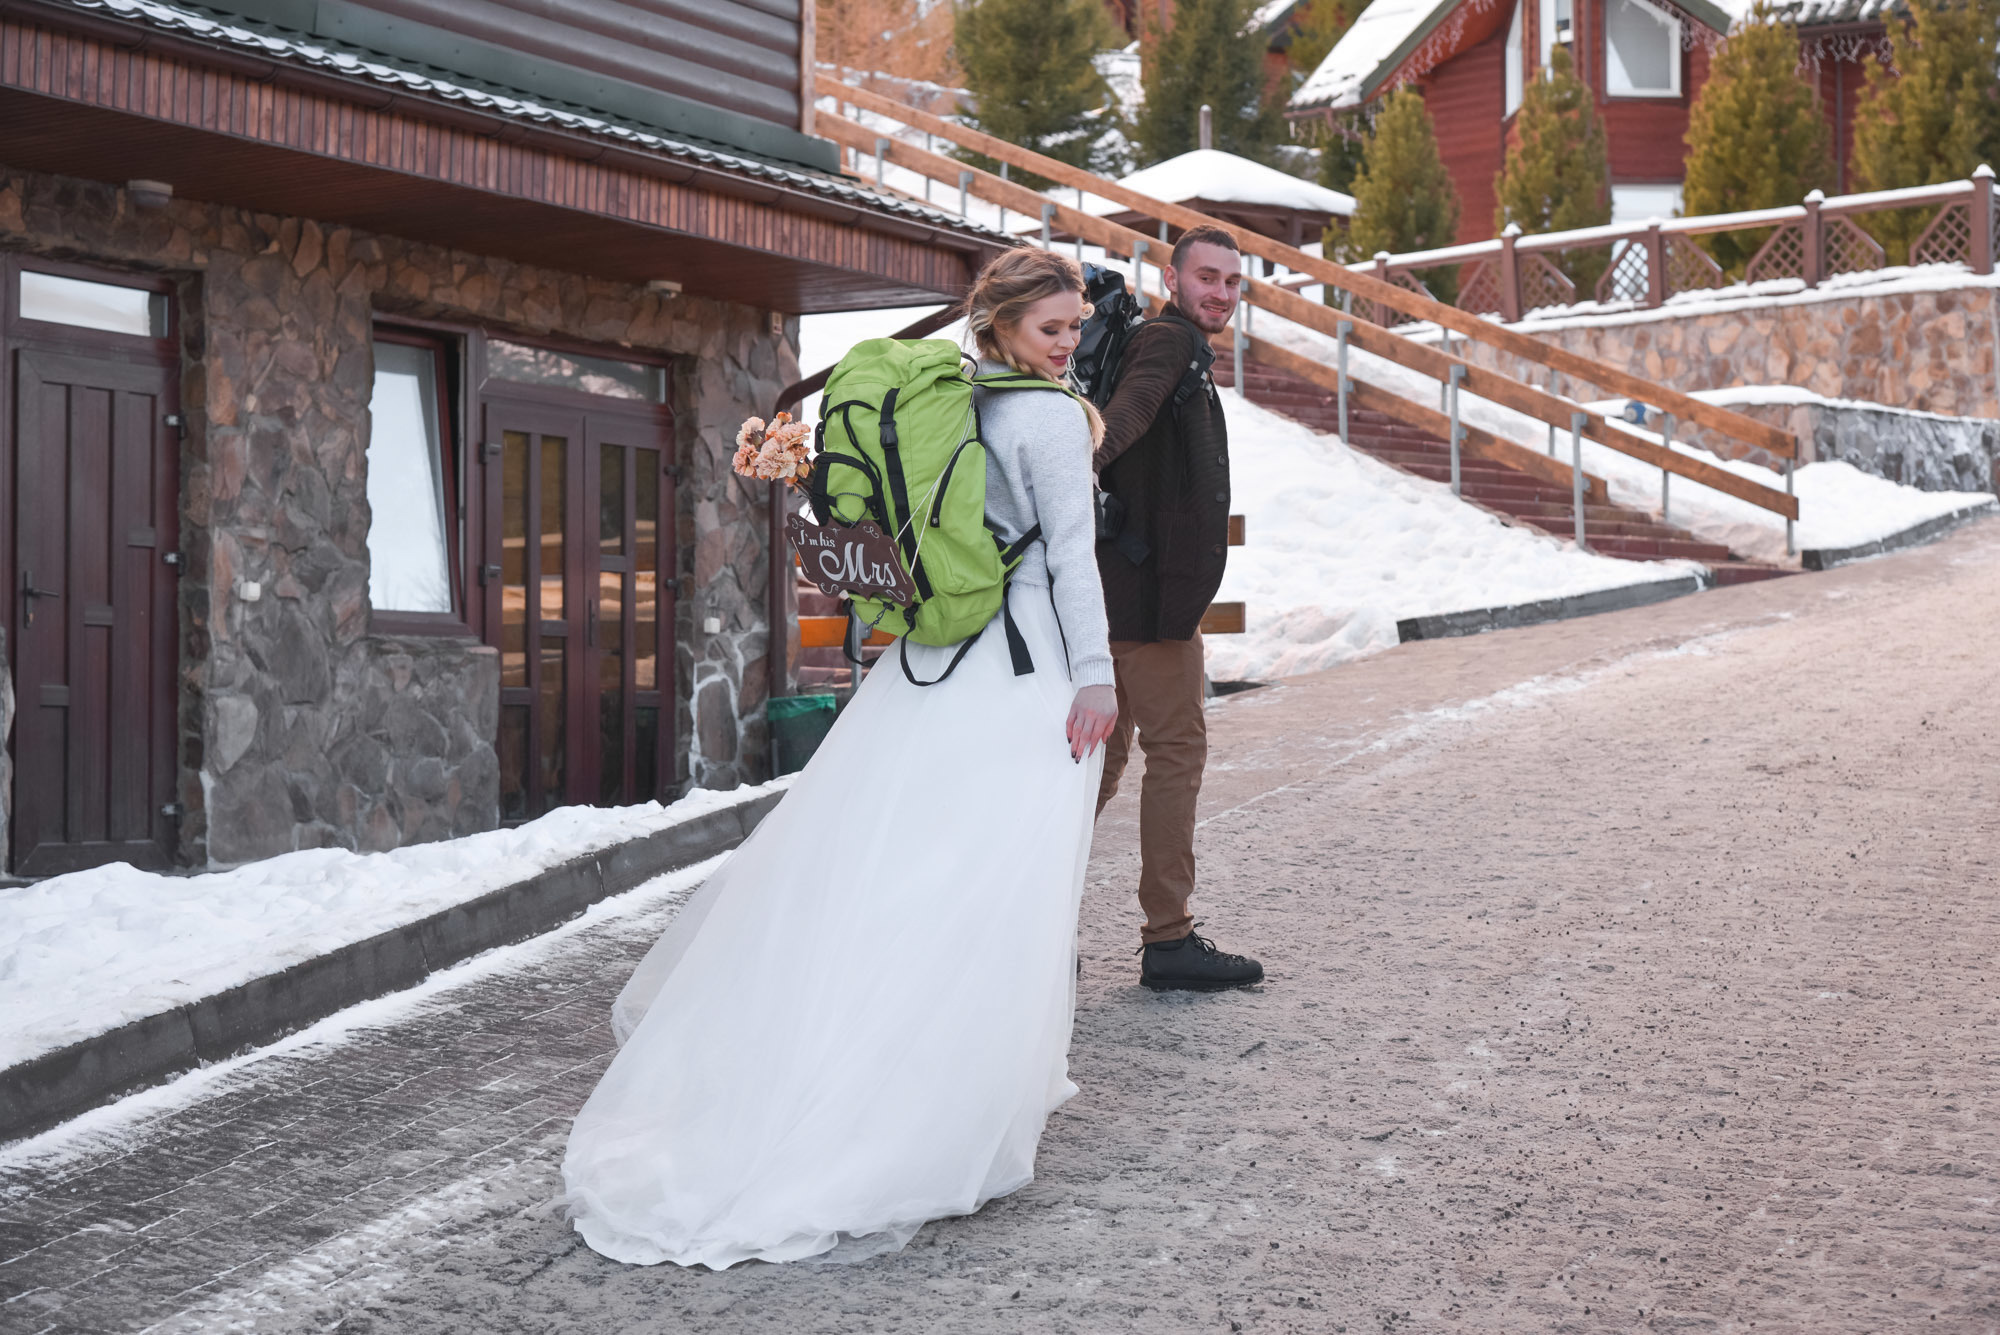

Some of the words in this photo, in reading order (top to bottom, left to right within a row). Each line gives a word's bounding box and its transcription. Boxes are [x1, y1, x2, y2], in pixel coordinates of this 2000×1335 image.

[798, 529, 819, 546] I'm
[819, 531, 836, 548] his
[818, 541, 897, 587] Mrs
